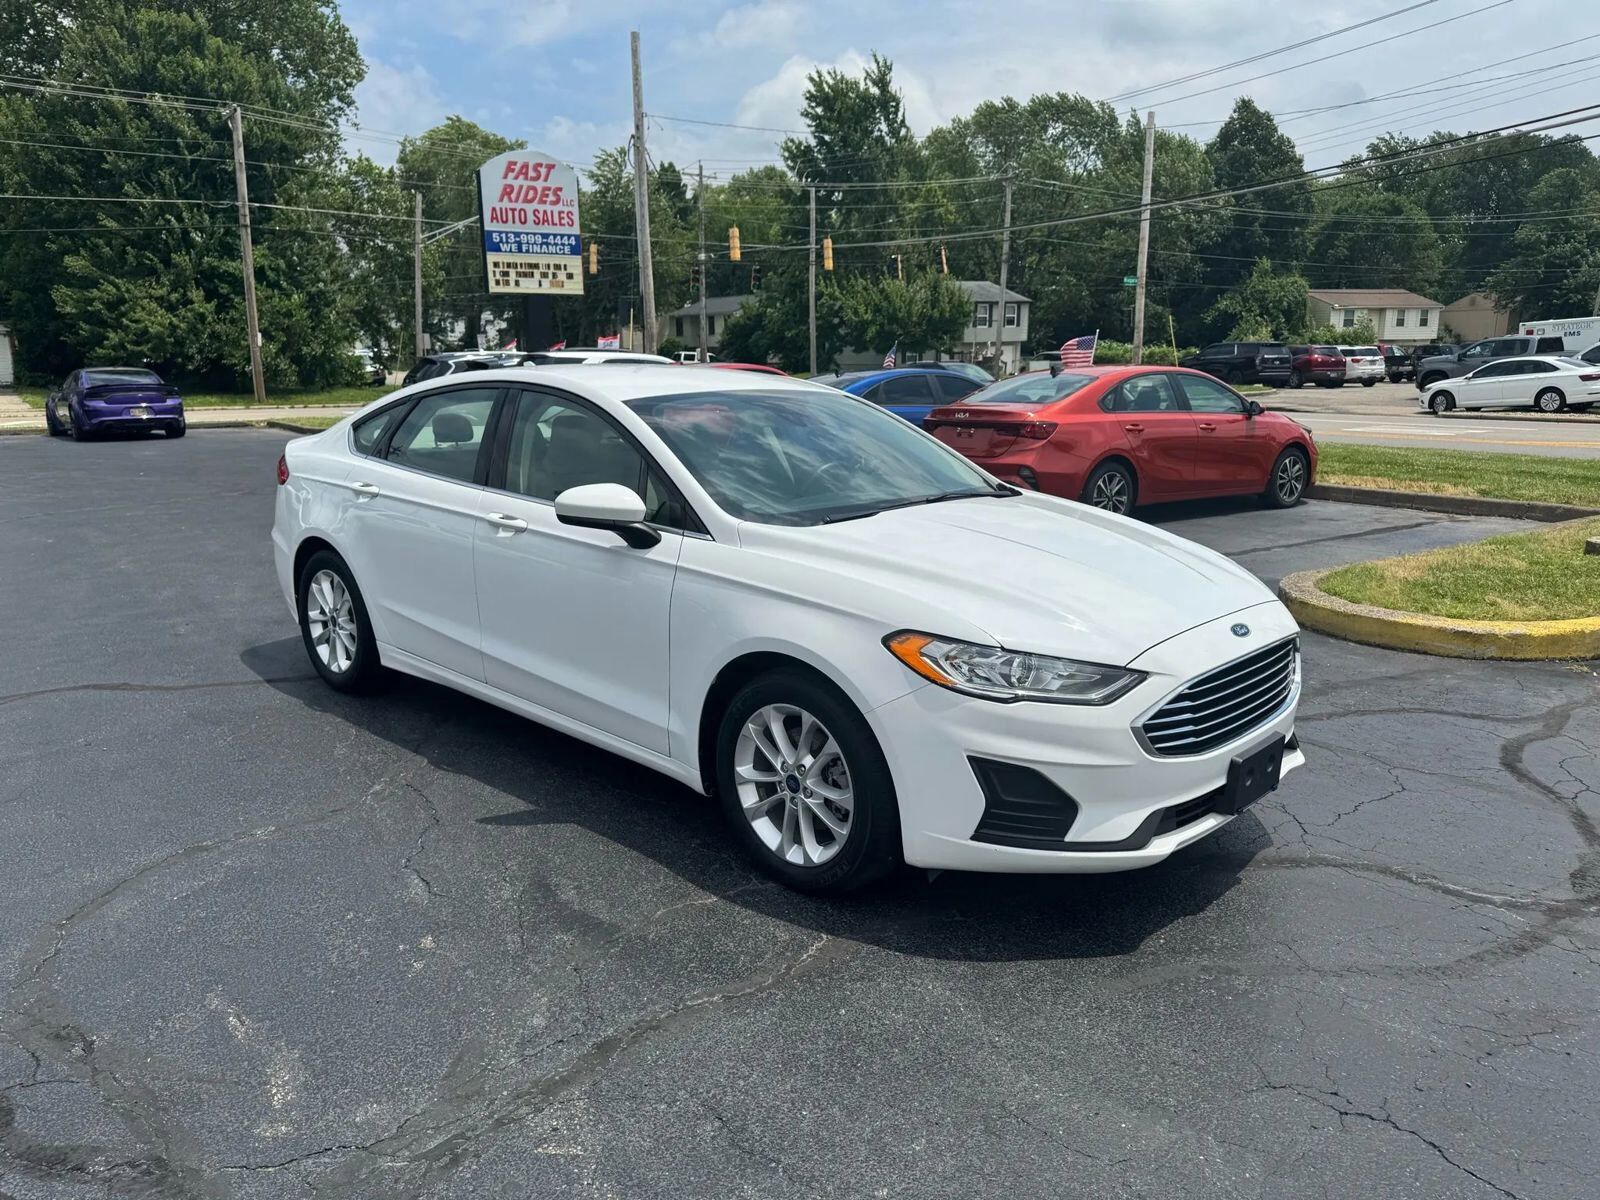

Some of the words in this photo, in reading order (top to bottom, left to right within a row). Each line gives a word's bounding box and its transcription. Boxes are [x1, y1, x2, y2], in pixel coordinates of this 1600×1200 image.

[502, 160, 556, 182] FAST
[498, 183, 563, 206] RIDES
[561, 198, 575, 208] LLC
[490, 206, 528, 225] AUTO
[532, 208, 575, 228] SALES
[492, 232, 576, 246] 513-999-4444
[500, 242, 518, 252] WE
[522, 244, 571, 254] FINANCE
[1551, 321, 1594, 331] STRATEGIC
